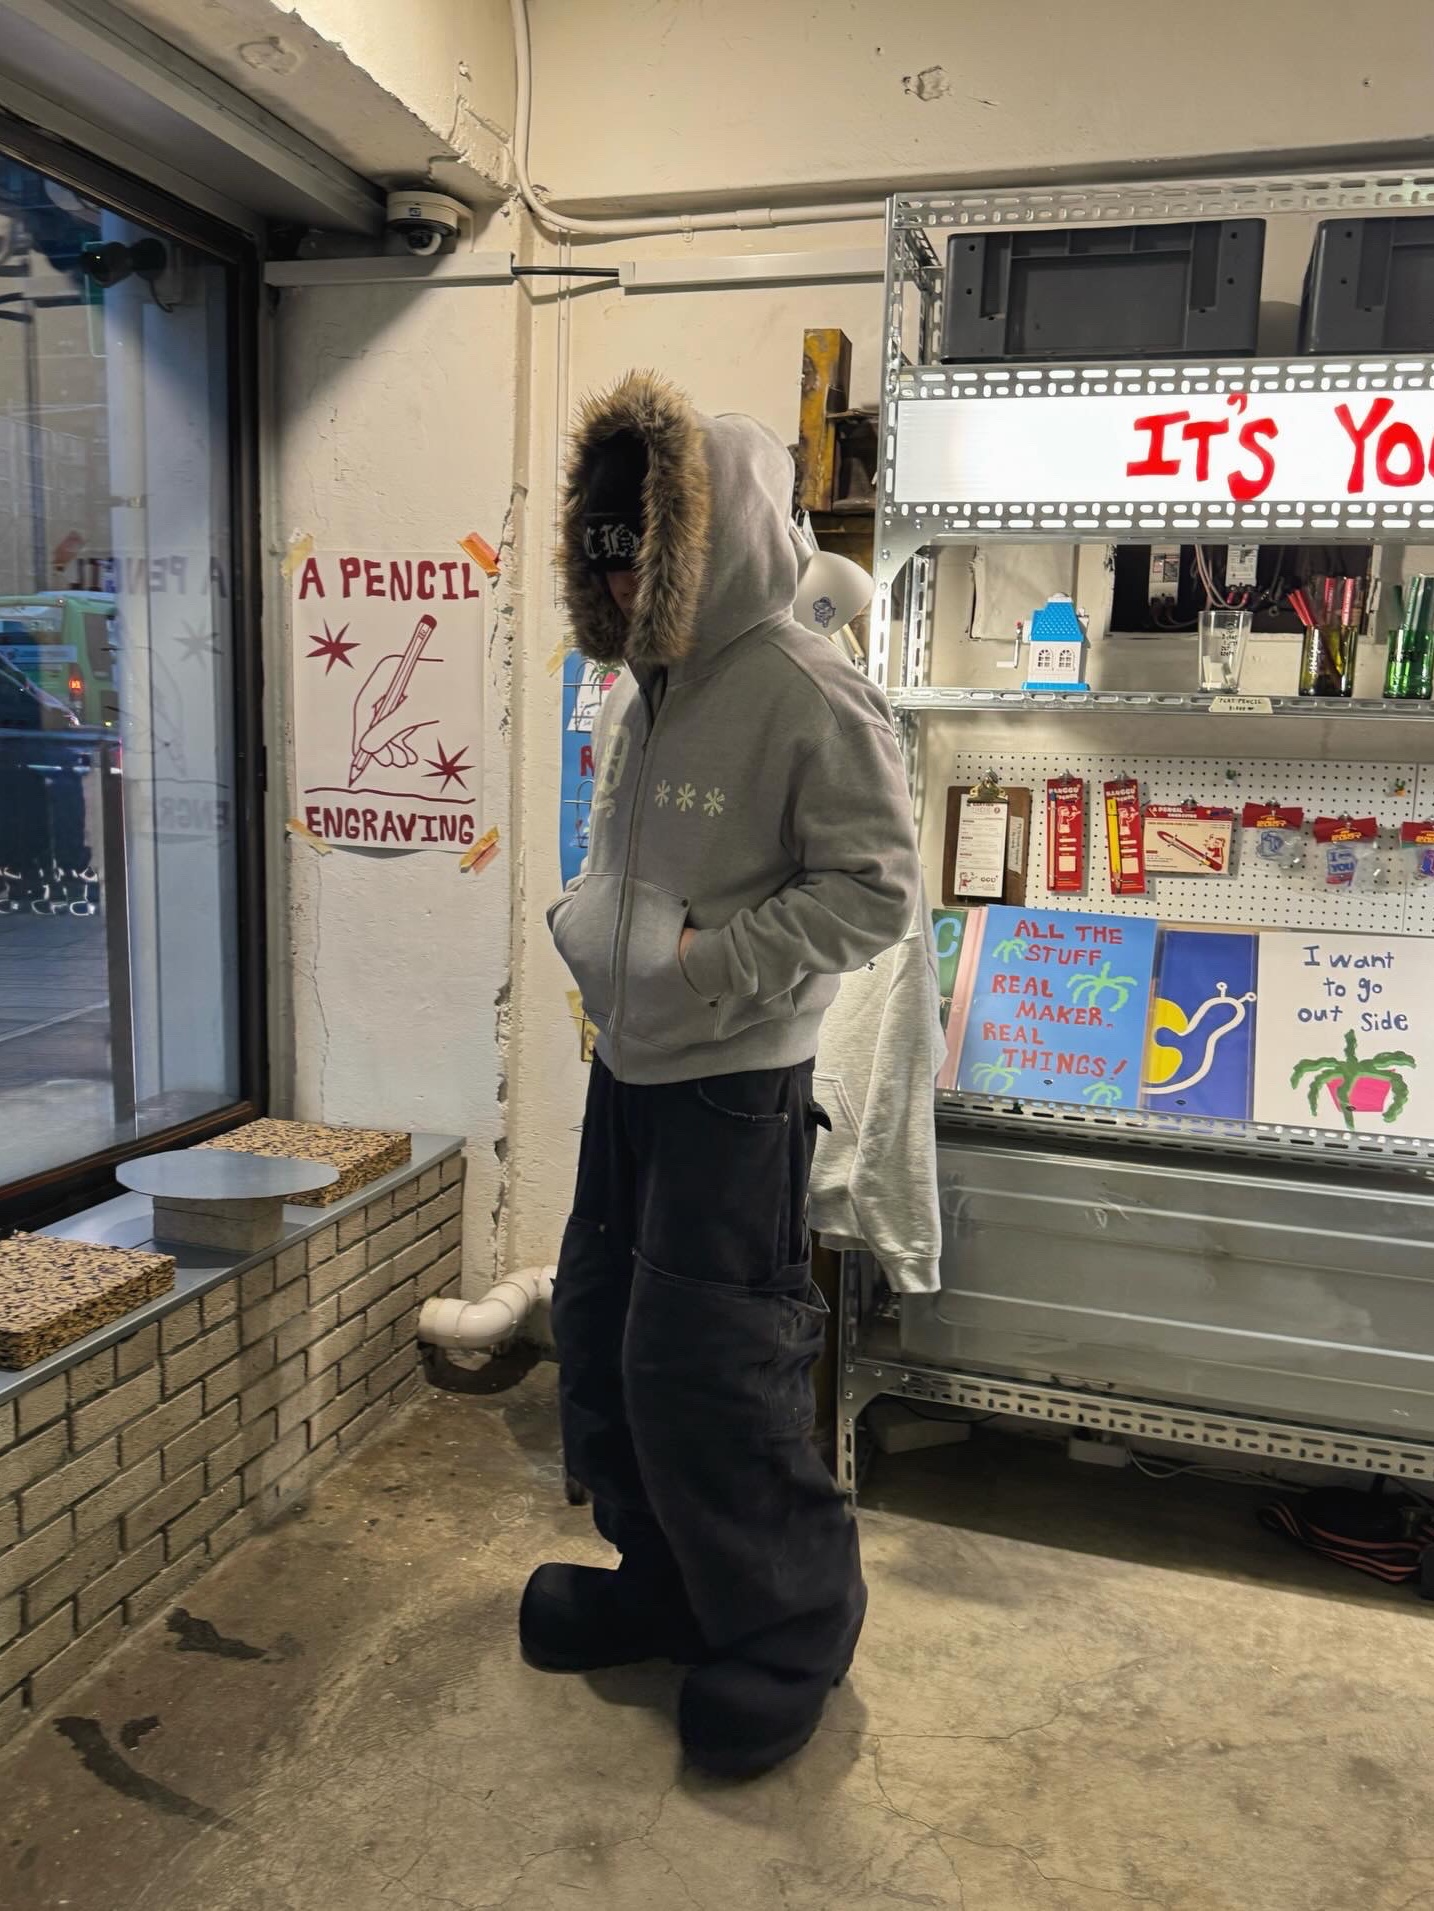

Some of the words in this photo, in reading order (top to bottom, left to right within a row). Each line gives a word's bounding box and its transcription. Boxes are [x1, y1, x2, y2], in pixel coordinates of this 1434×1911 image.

[1127, 392, 1279, 501] IT'S
[1334, 398, 1434, 493] YO
[299, 558, 325, 599] A
[339, 557, 479, 601] PENCIL
[305, 806, 475, 844] ENGRAVING
[1013, 919, 1065, 940] ALL
[1075, 925, 1124, 945] THE
[1024, 944, 1102, 967] STUFF
[1303, 945, 1321, 967] I
[1330, 951, 1394, 969] want
[992, 974, 1054, 998] REAL
[1323, 977, 1347, 997] to
[1357, 977, 1383, 1003] go
[1298, 1005, 1343, 1023] out
[982, 1022, 1044, 1045] REAL
[1002, 1048, 1128, 1080] THINGS!
